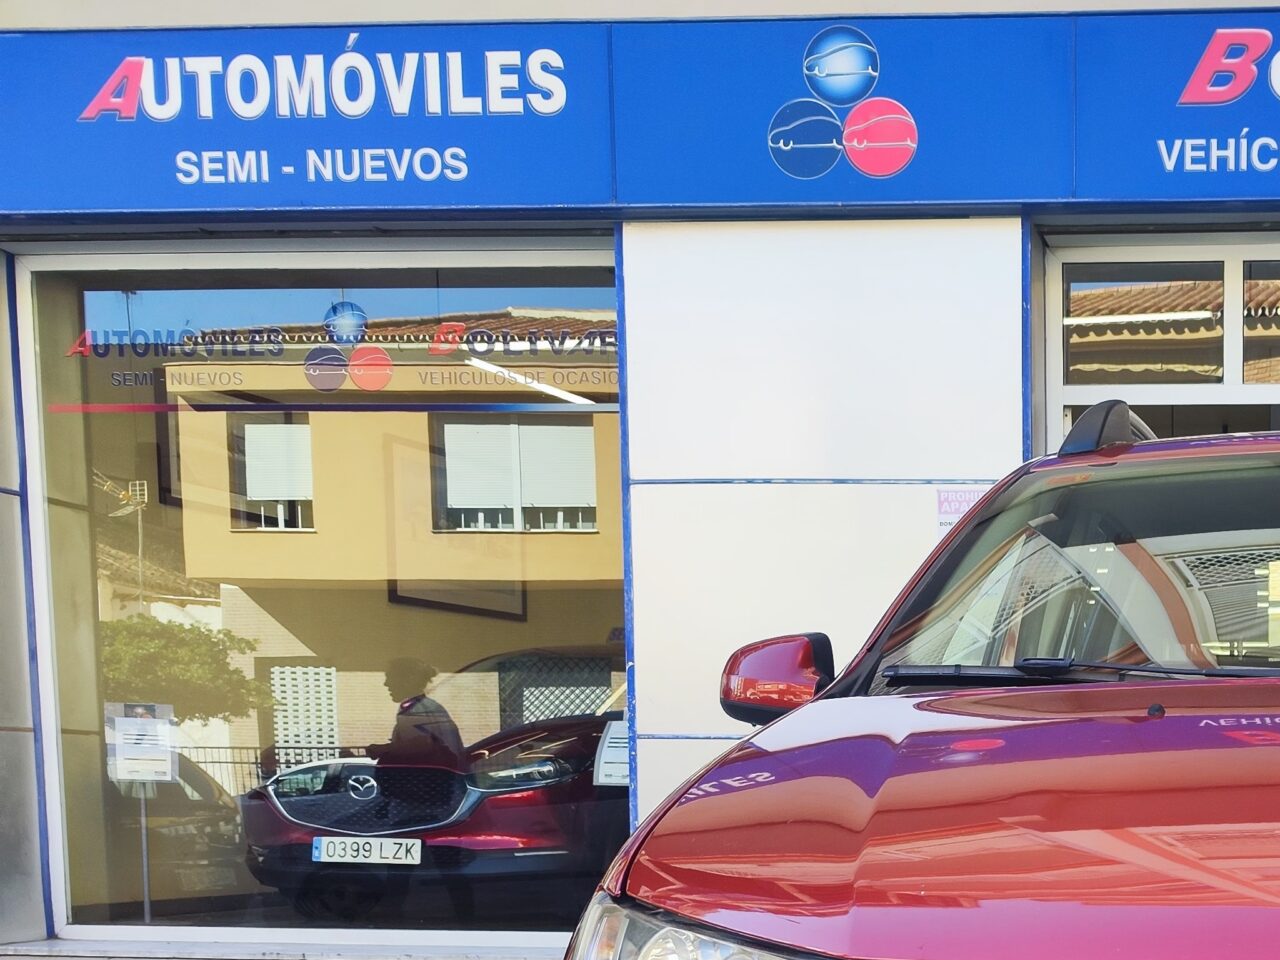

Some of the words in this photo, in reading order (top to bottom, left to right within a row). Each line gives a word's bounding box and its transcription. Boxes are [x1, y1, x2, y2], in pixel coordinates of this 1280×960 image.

[76, 33, 567, 122] AUTOMÓVILES
[175, 149, 270, 185] SEMI
[305, 146, 468, 183] NUEVOS
[64, 320, 285, 359] AUTOMÓVILES
[111, 371, 153, 387] SEMI
[170, 371, 243, 386] NUEVOS
[524, 371, 547, 385] DE
[326, 840, 372, 858] 0399
[379, 842, 416, 860] LZK
